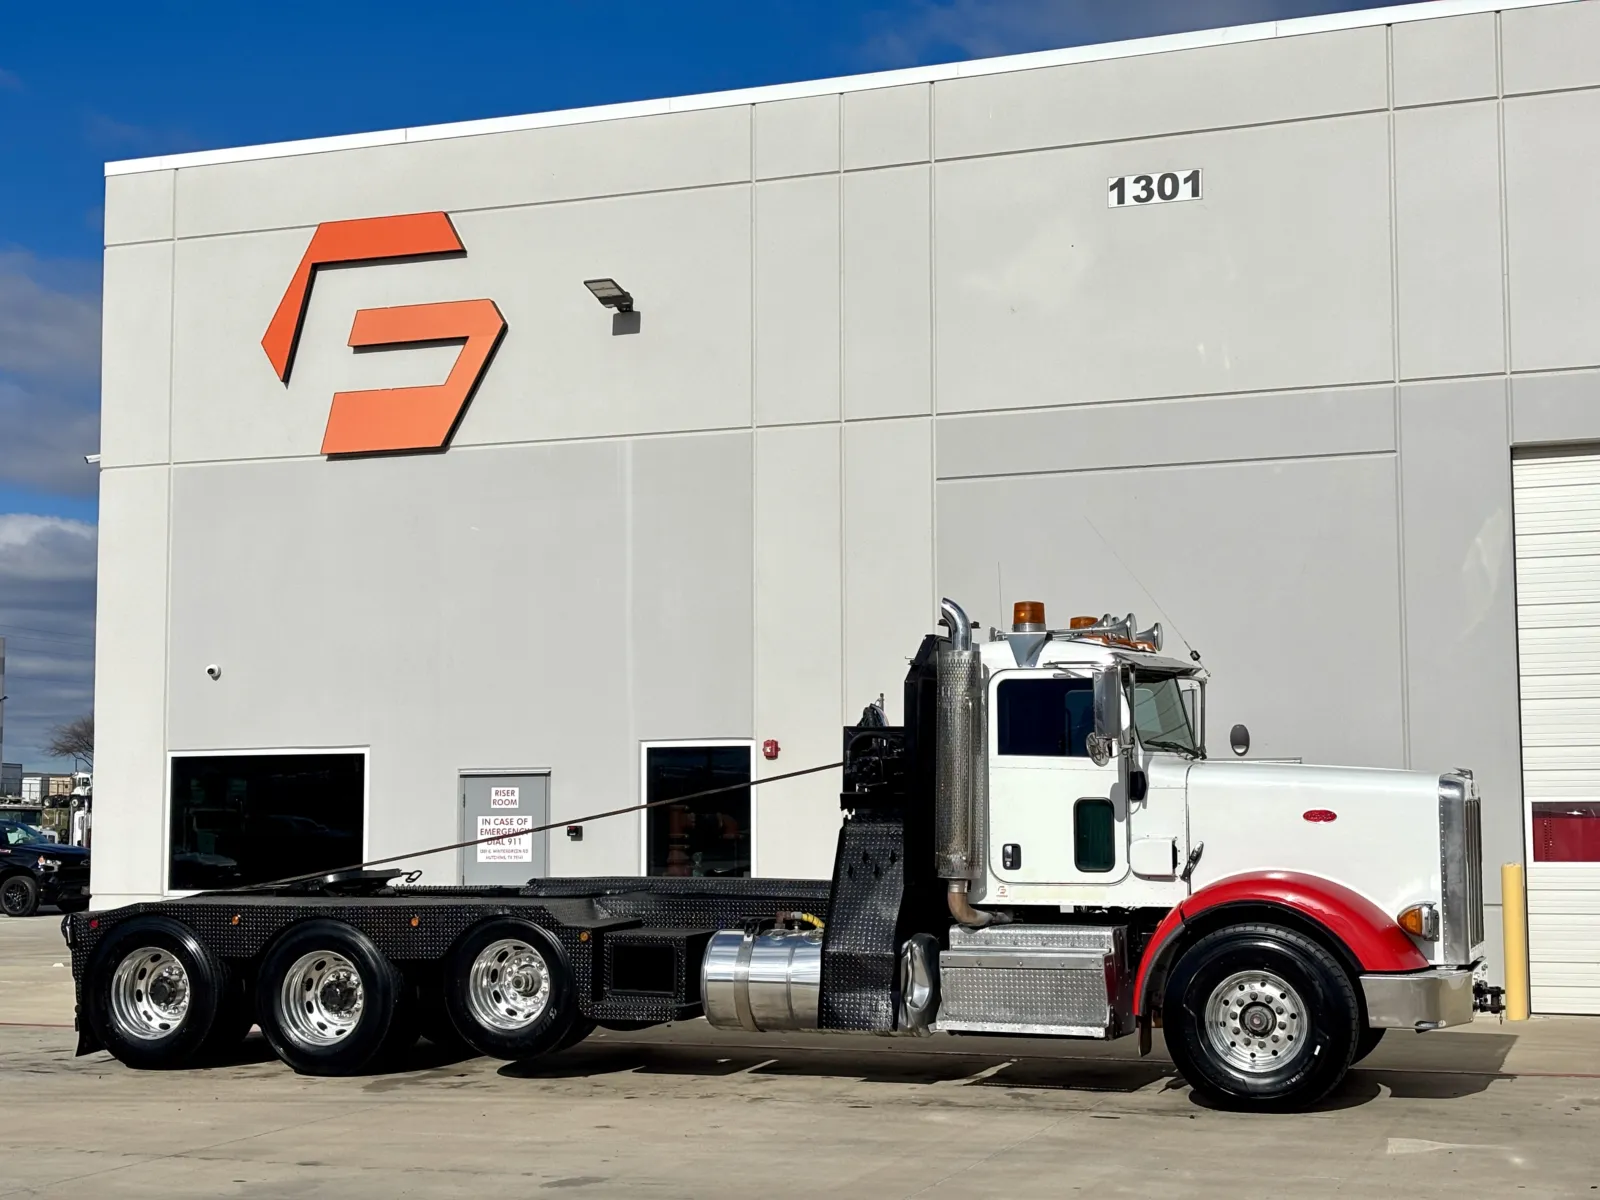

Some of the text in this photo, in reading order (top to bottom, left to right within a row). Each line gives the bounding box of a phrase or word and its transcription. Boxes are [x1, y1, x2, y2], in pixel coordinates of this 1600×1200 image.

[1109, 169, 1200, 205] 1301
[495, 789, 515, 797] RISER
[481, 818, 528, 826] IN CASE OF
[486, 837, 522, 846] DIAL 911
